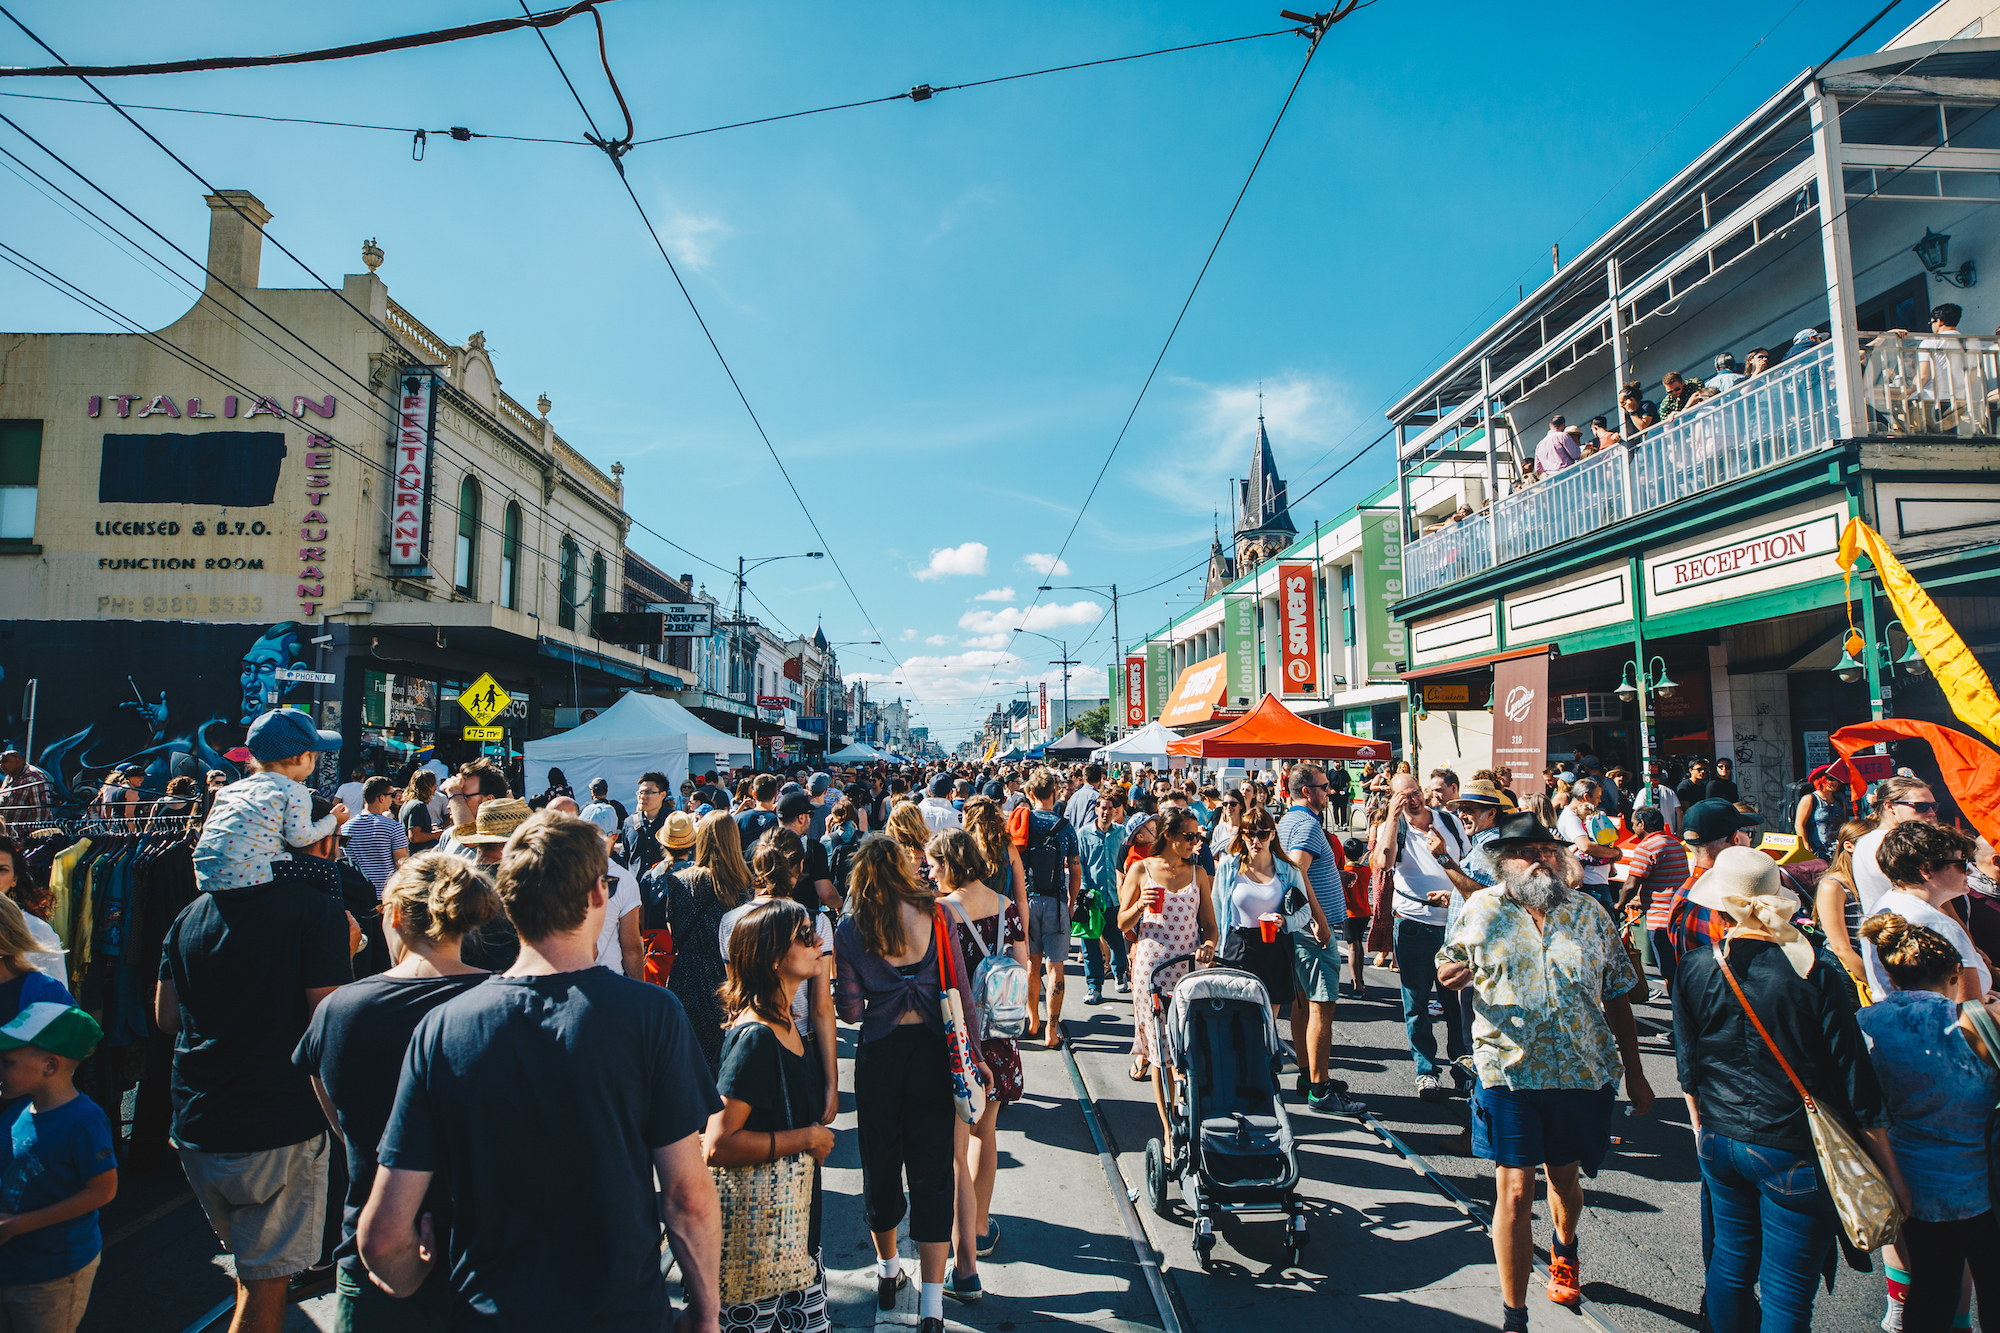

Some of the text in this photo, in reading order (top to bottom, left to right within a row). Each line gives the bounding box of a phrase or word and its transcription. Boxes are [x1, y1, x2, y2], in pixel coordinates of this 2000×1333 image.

[87, 395, 336, 419] ITALIAN
[442, 406, 483, 446] ORIA
[394, 396, 426, 559] RESTAURANT
[95, 521, 272, 536] LICENSED & B.Y.O.
[297, 434, 334, 616] RESTAURANT
[1379, 520, 1399, 571] here
[1673, 530, 1808, 585] RECEPTION
[98, 558, 264, 570] FUNCTION ROOM
[98, 596, 263, 612] PH: 9380 5533
[1287, 576, 1307, 656] savers
[664, 614, 708, 623] UNSWICK
[1382, 578, 1406, 657] donte
[1155, 646, 1166, 672] here
[1236, 599, 1252, 696] donate here
[295, 672, 327, 682] PHOENIX
[374, 679, 429, 698] Funtion Rooms
[1130, 663, 1141, 706] savers
[390, 698, 417, 711] vailable
[472, 730, 484, 738] 75
[1511, 735, 1522, 744] 318
[1842, 763, 1883, 776] TLETS
